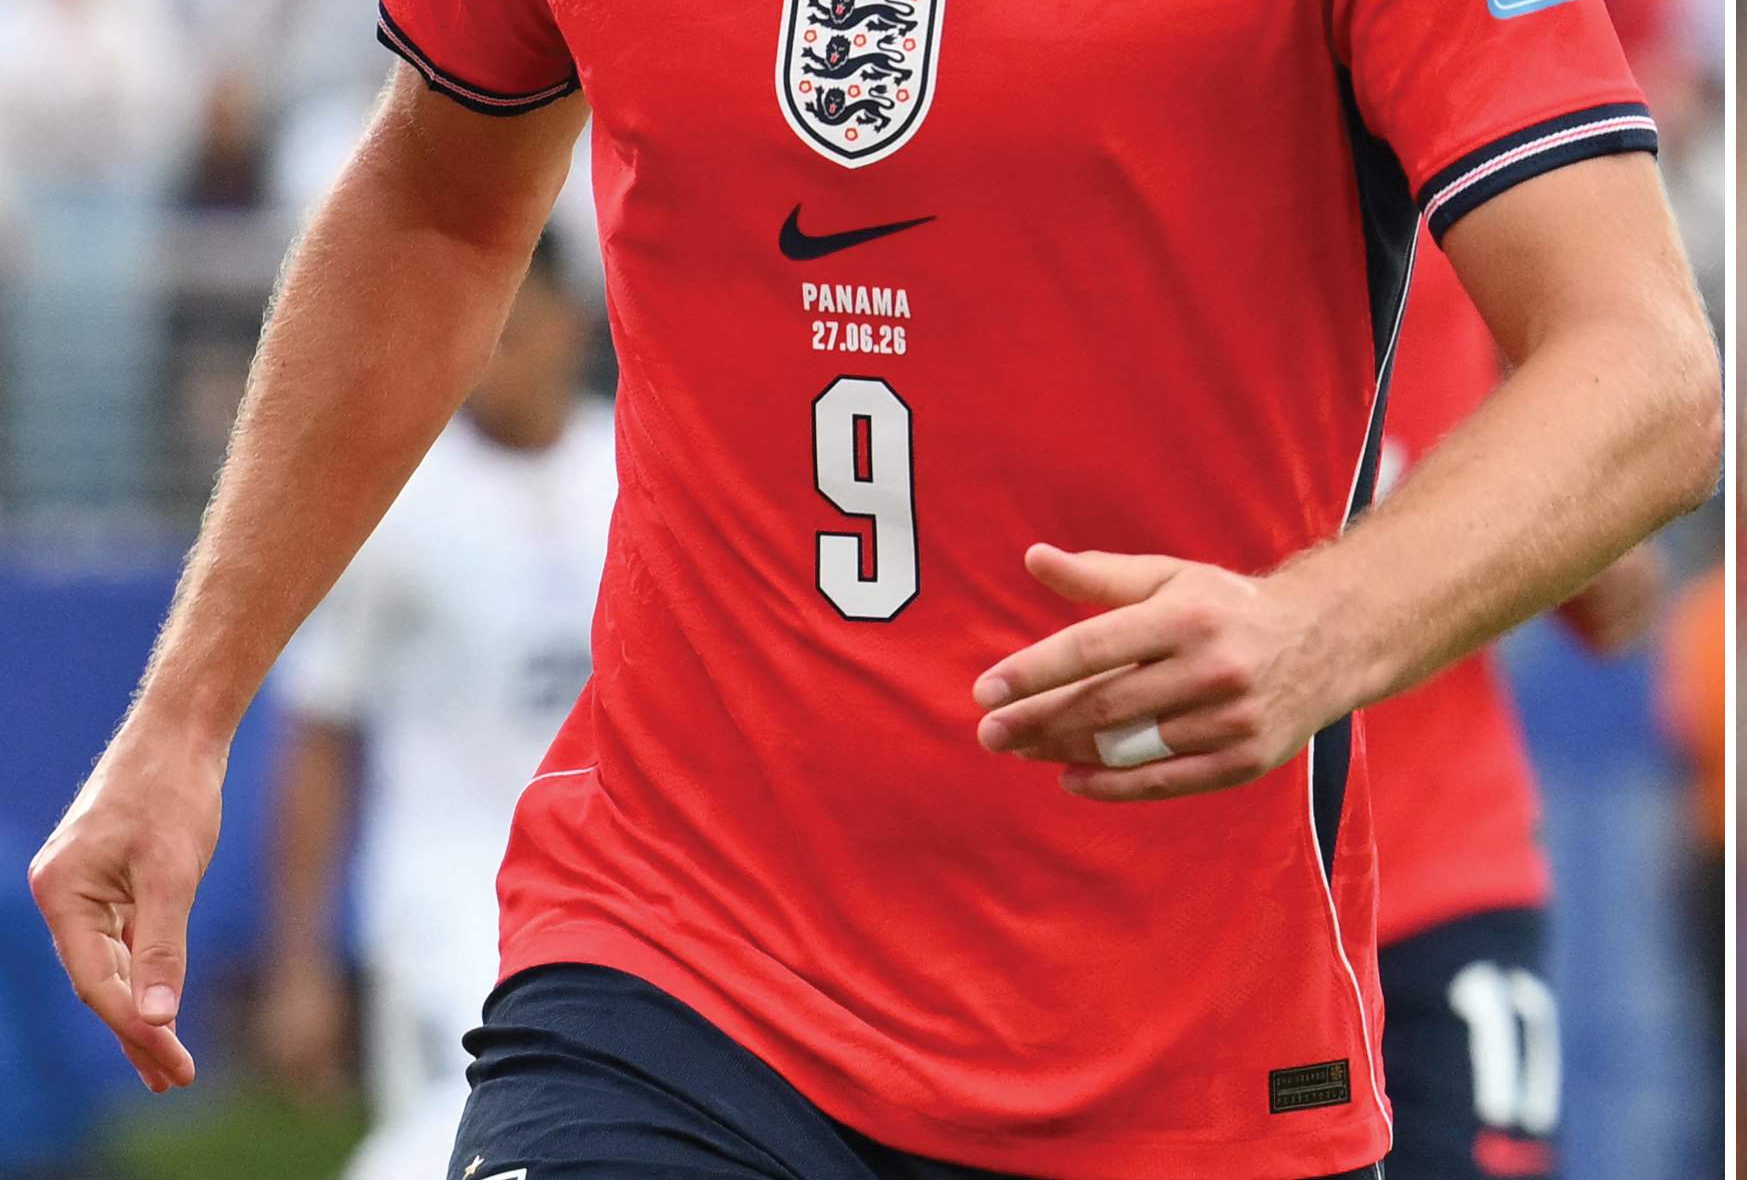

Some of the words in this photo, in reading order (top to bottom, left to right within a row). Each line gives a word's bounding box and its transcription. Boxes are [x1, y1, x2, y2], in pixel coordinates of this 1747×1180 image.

[801, 282, 911, 318] PANAMA
[812, 320, 907, 355] 27.06.26
[812, 374, 919, 621] 9
